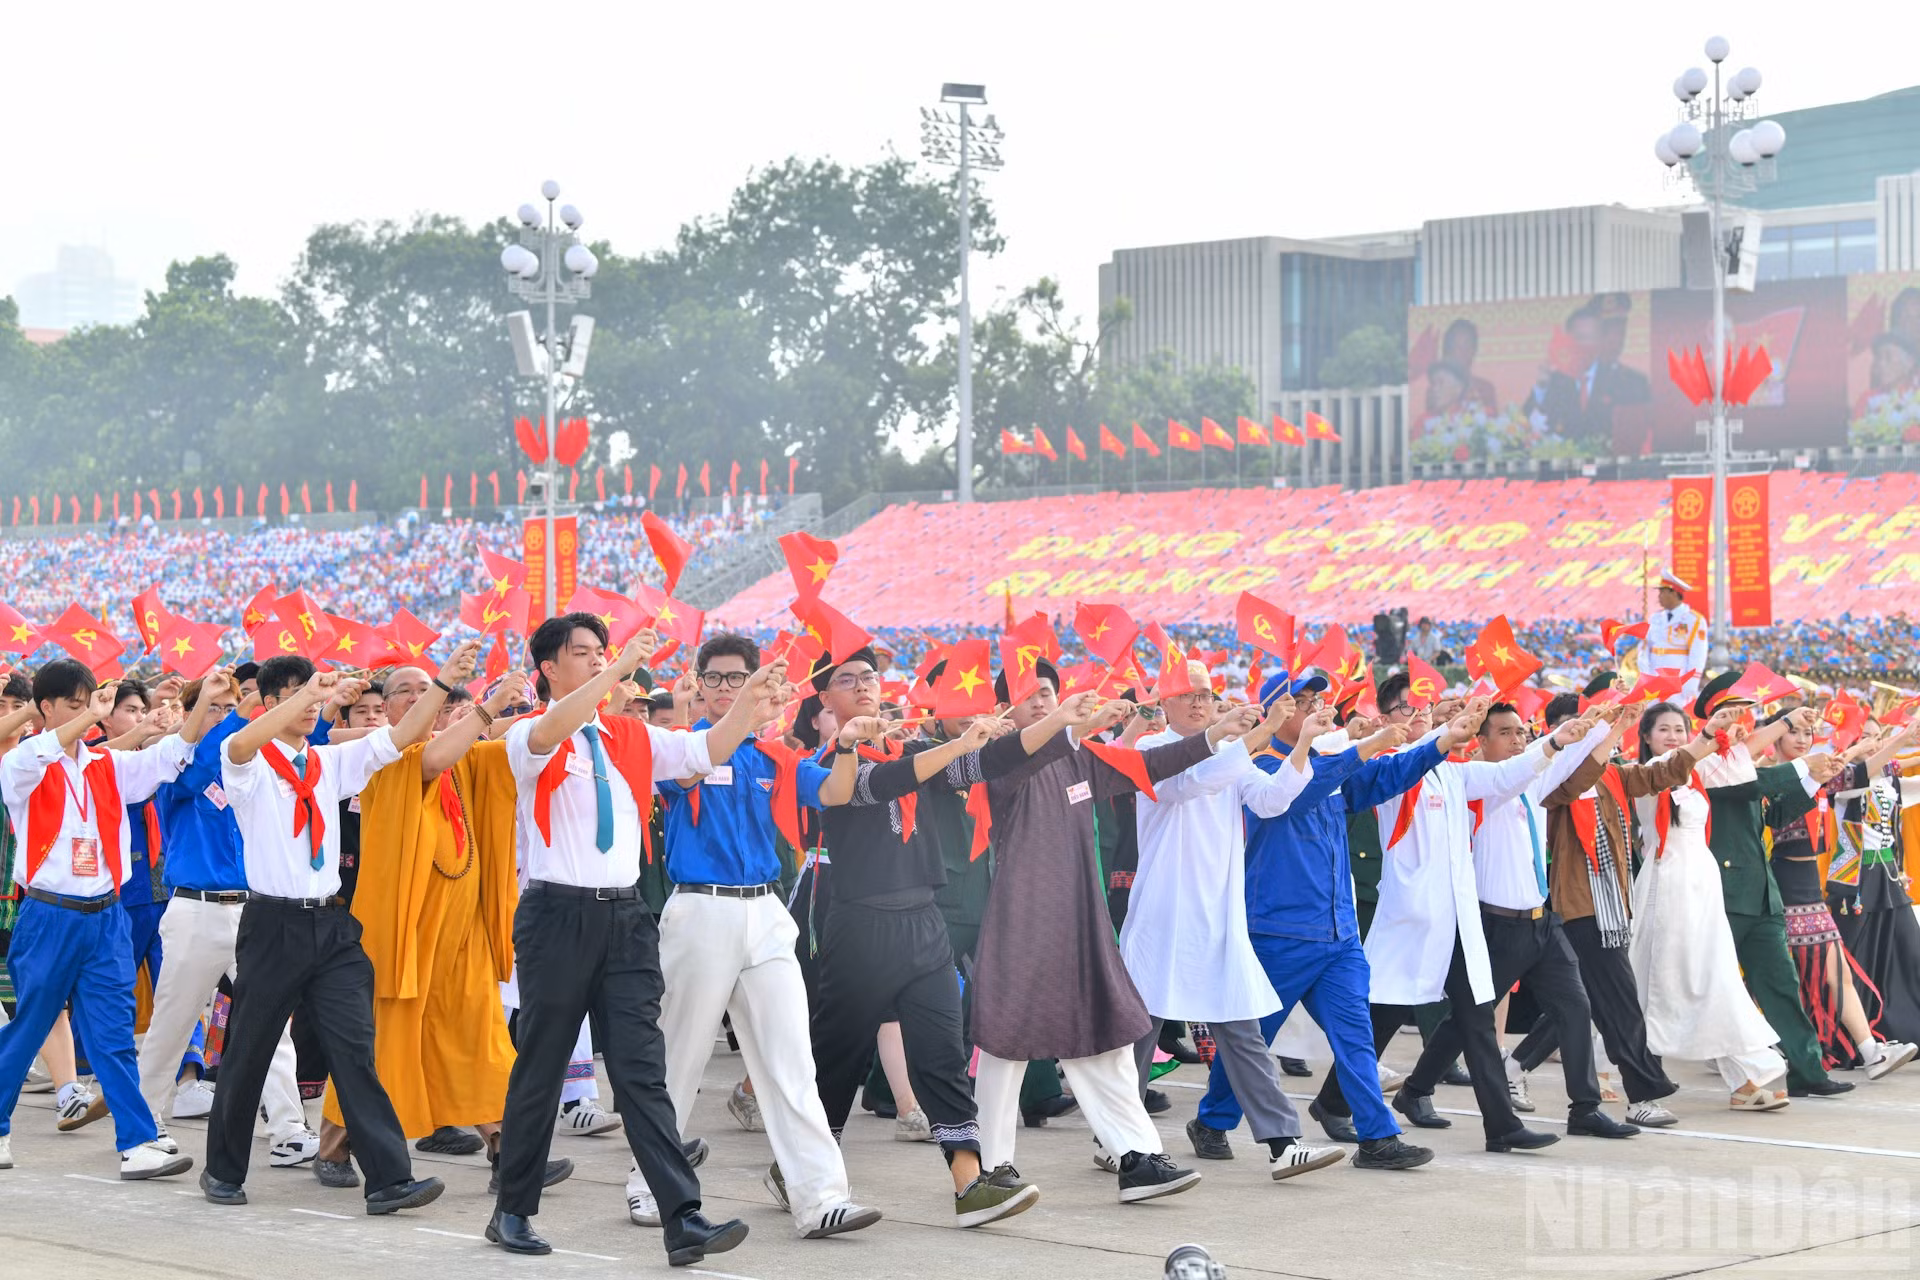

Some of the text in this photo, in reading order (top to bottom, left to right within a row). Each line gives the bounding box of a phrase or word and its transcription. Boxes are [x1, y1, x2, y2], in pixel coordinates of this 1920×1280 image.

[1264, 519, 1530, 560] CỘNG
[985, 564, 1280, 597] QUANG
[1306, 560, 1525, 593] VINH
